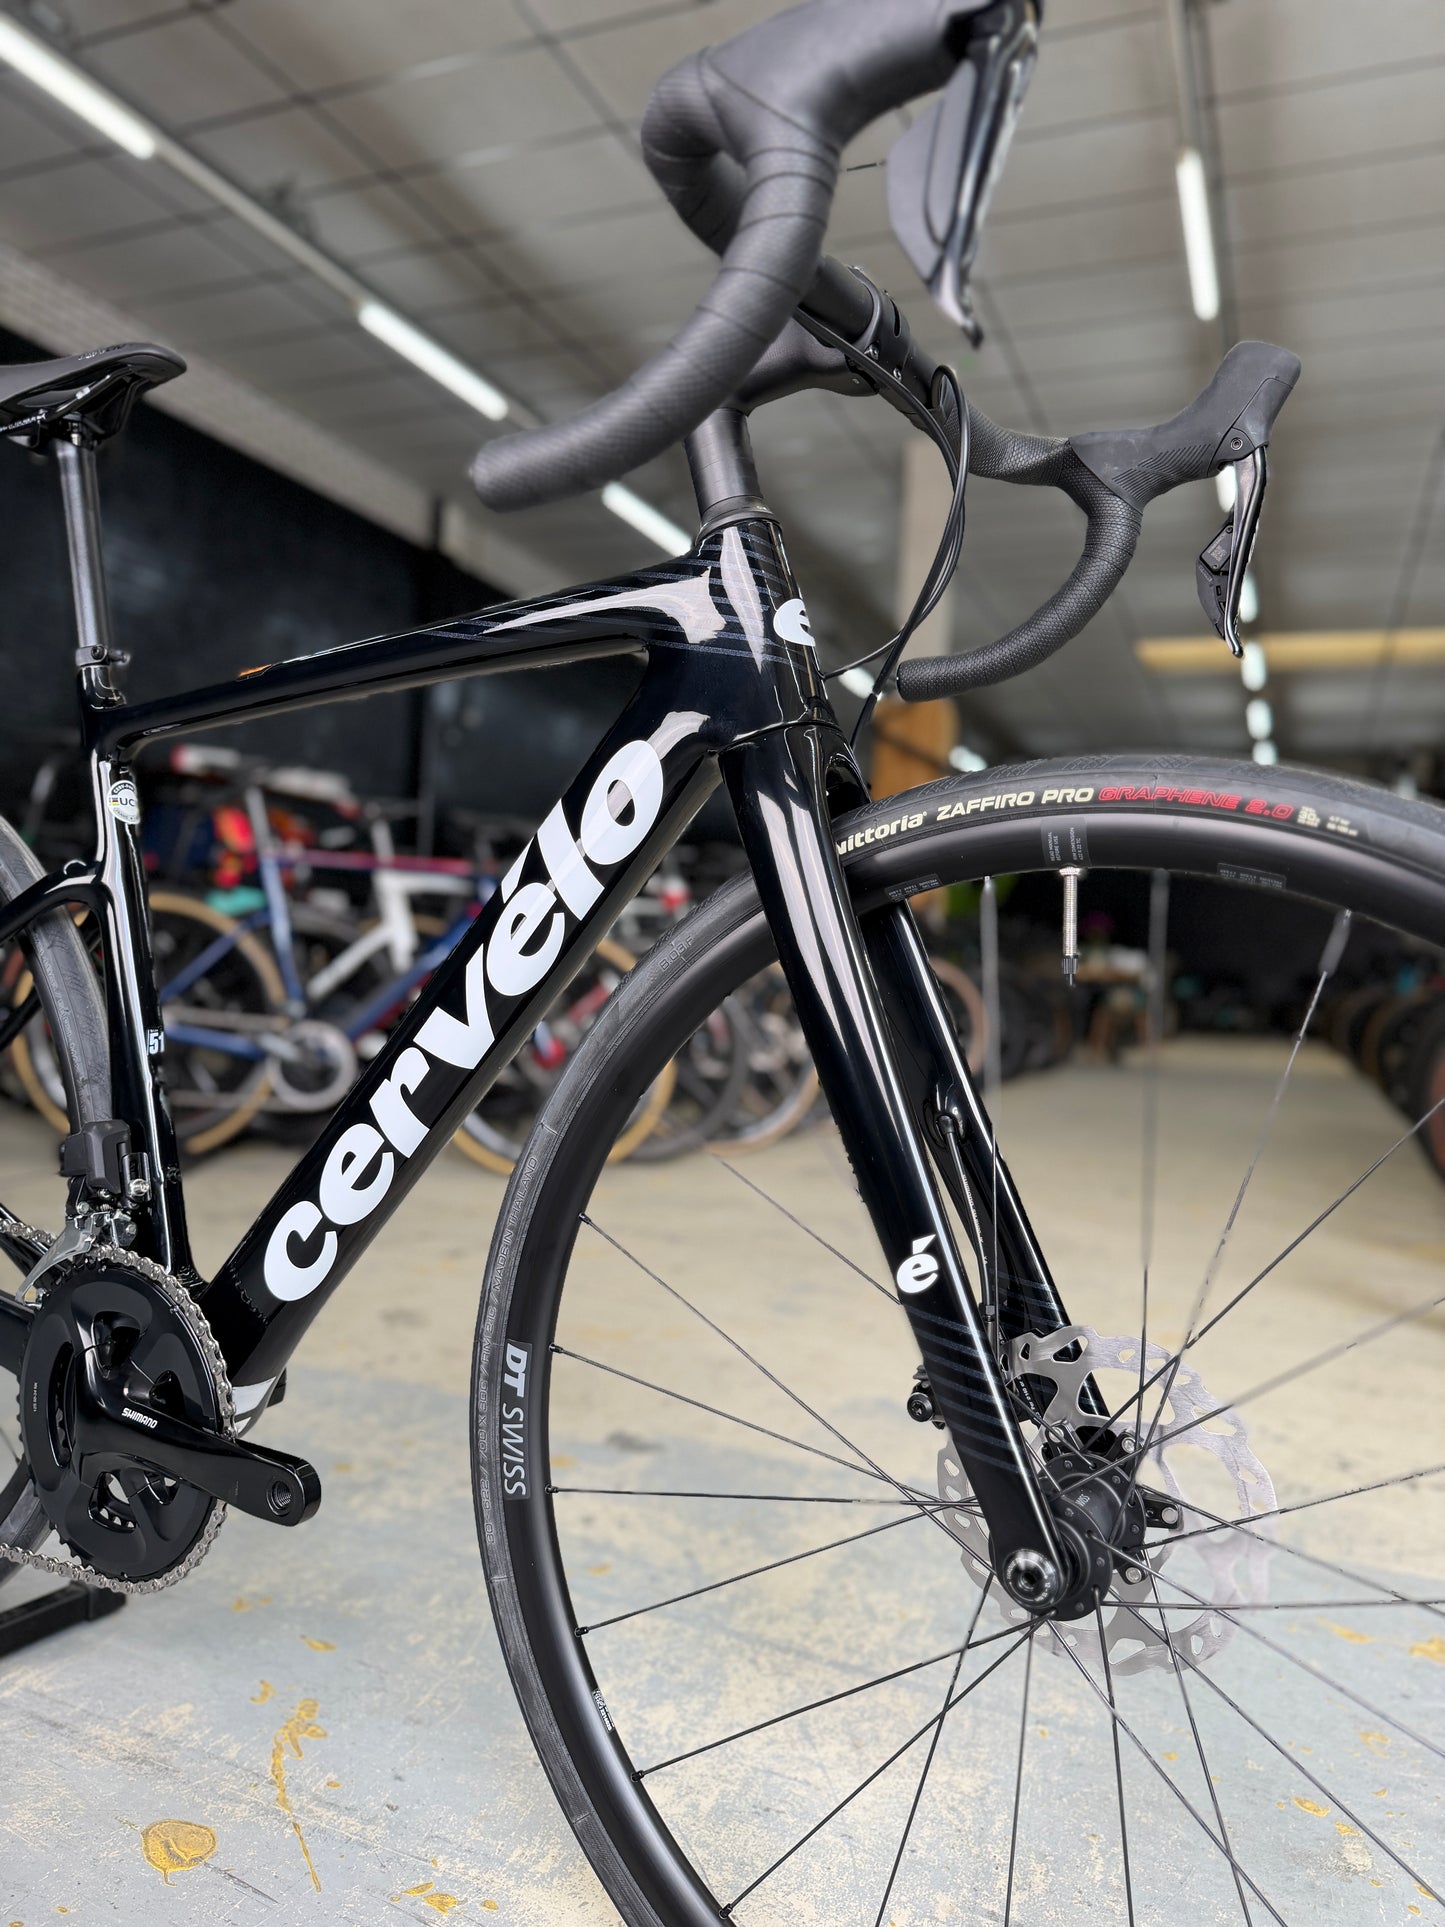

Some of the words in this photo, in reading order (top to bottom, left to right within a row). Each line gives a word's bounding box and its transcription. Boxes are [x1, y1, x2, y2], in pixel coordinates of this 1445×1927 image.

[119, 797, 137, 807] UC
[936, 791, 1035, 821] ZAFFIRO
[1041, 787, 1094, 805] PRO
[1098, 786, 1243, 810] GRAPHENE
[1244, 799, 1295, 820] 2.0
[149, 1031, 165, 1055] 51
[263, 740, 664, 1302] cervélo
[493, 1247, 509, 1291] MADE
[509, 1156, 538, 1228] THAILAND
[897, 1234, 939, 1293] é
[503, 1342, 528, 1398] DT
[121, 1407, 158, 1429] SHIMANO
[502, 1402, 526, 1496] SWISS
